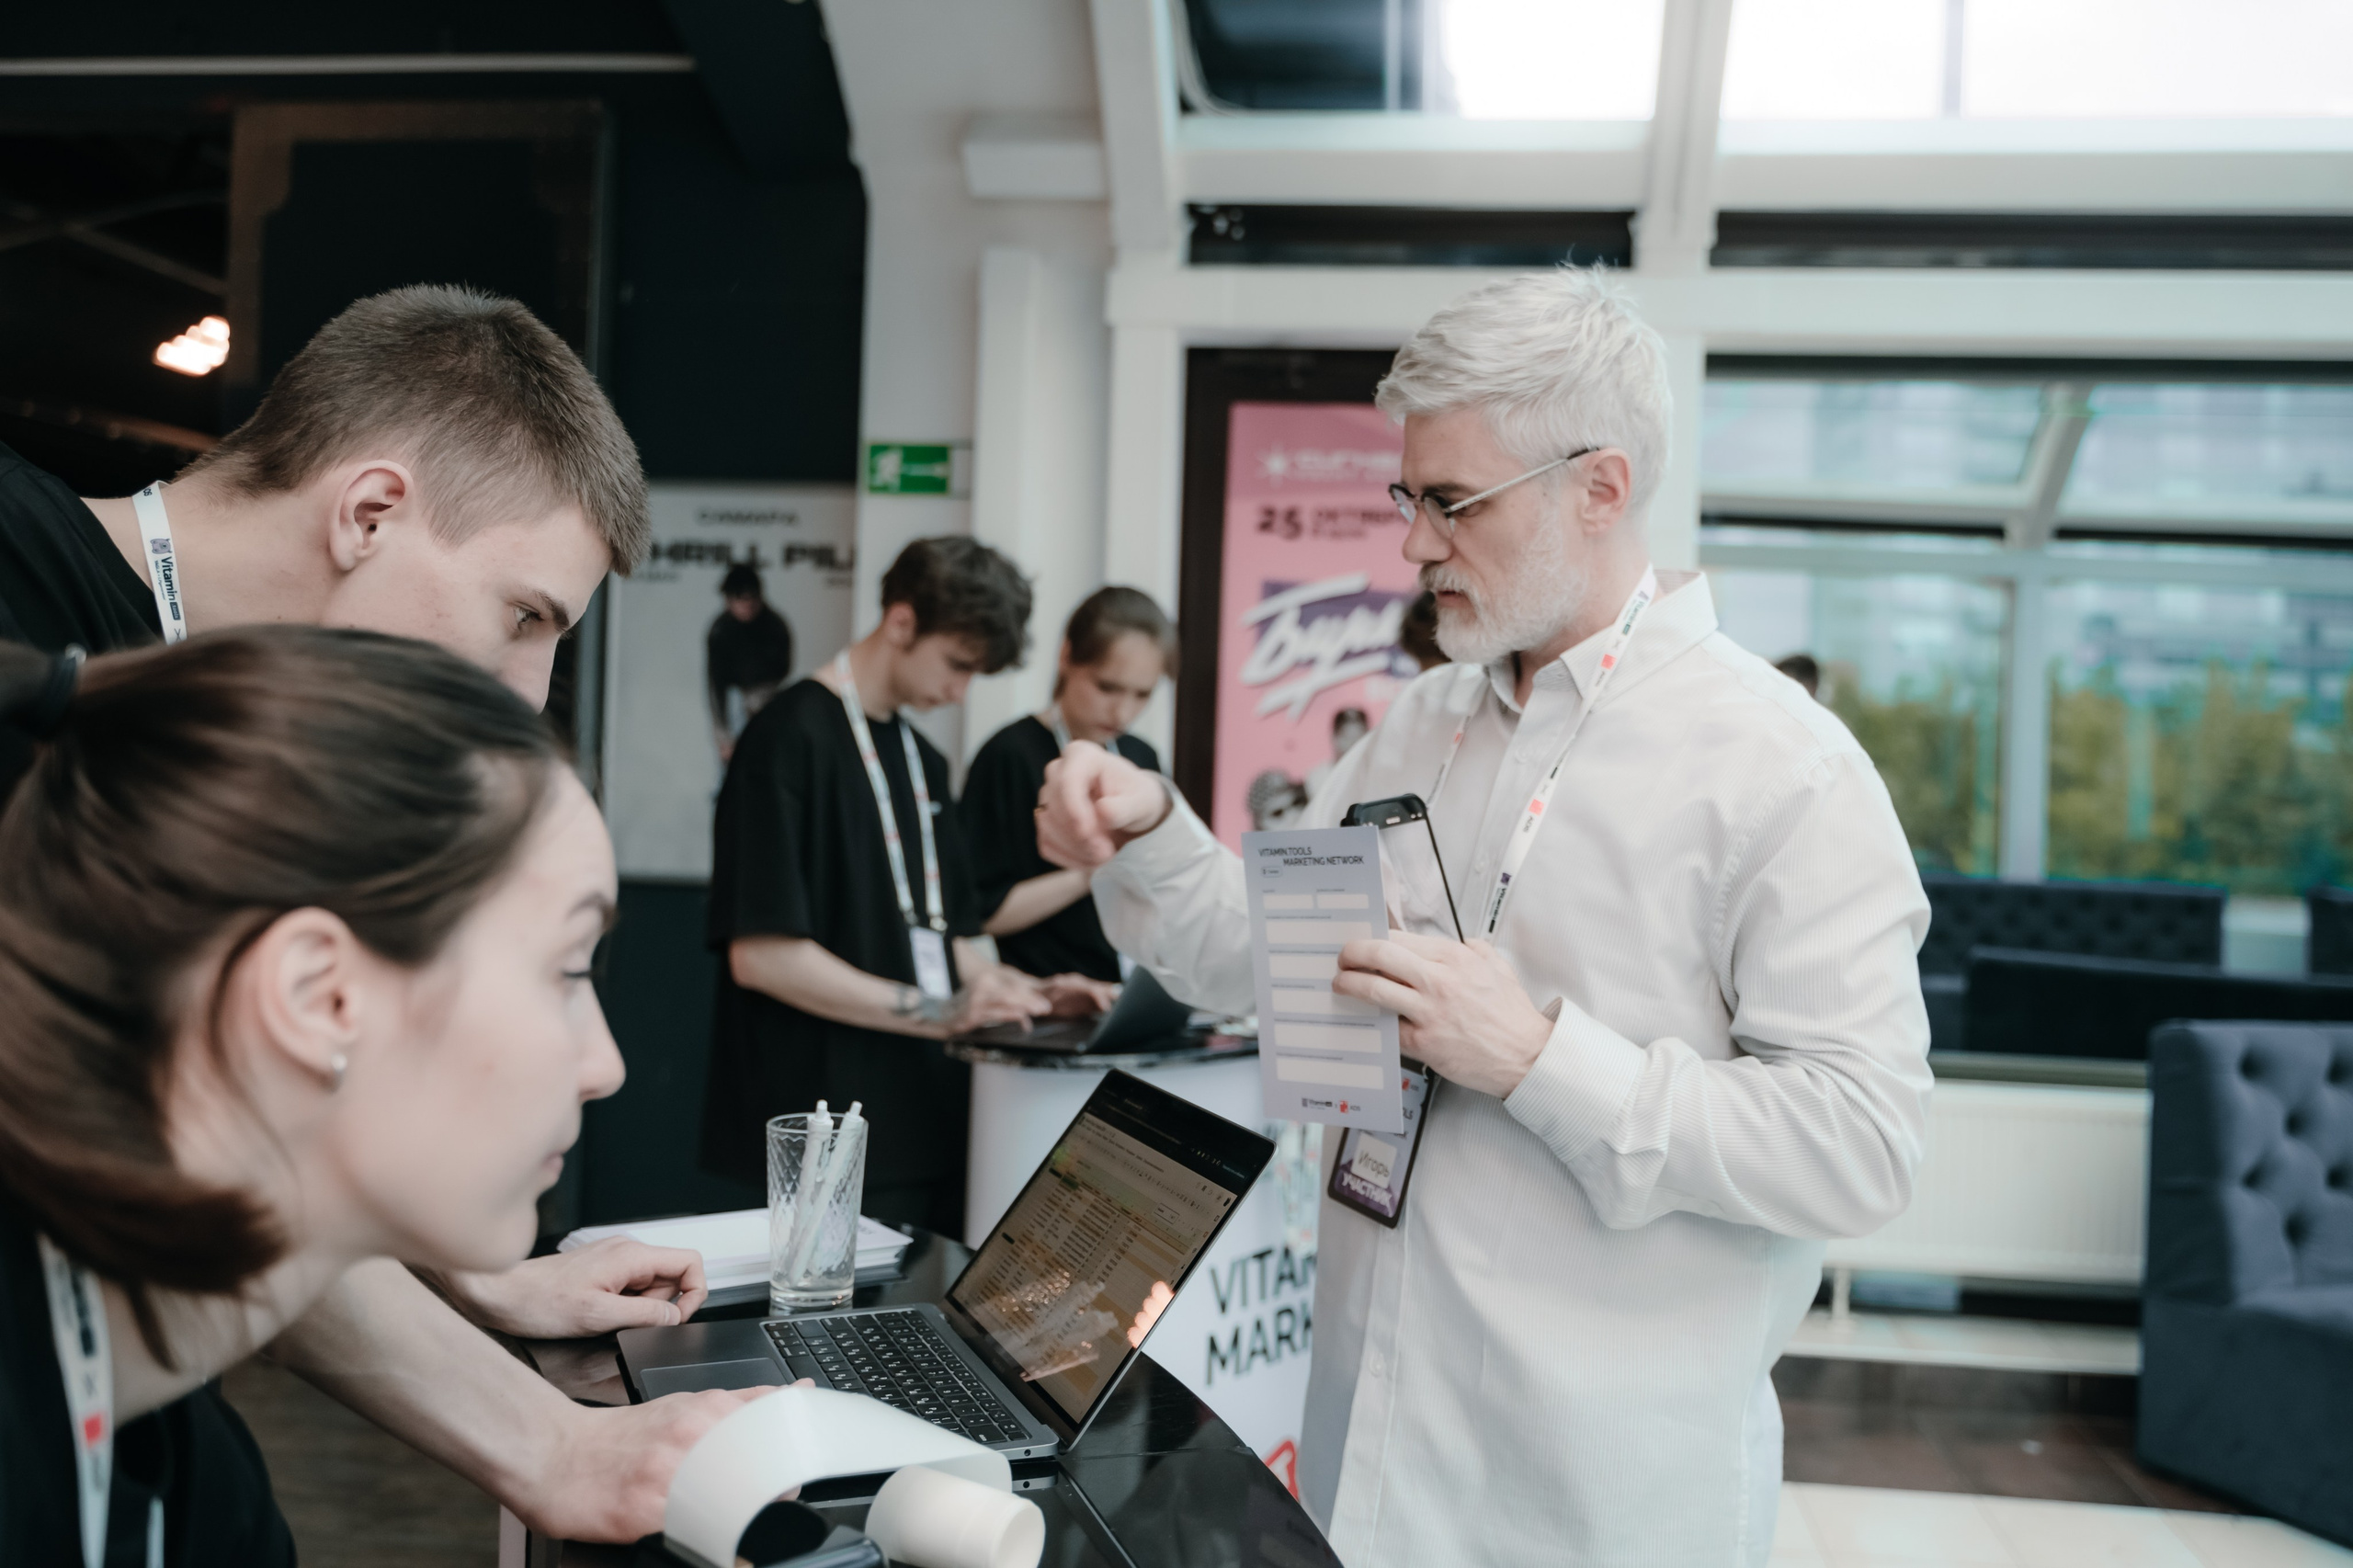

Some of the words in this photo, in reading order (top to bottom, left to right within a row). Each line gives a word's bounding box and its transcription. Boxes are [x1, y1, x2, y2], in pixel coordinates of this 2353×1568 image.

[161, 556, 177, 601] Vitamin
[1282, 857, 1325, 867] MARKETING
[1326, 856, 1364, 865] NETWORK
[1493, 888, 1506, 919] Vitamin
[1358, 1150, 1391, 1178] Игорь
[1342, 1172, 1393, 1218] УЧАСТНИК
[1209, 1246, 1317, 1314] VITA
